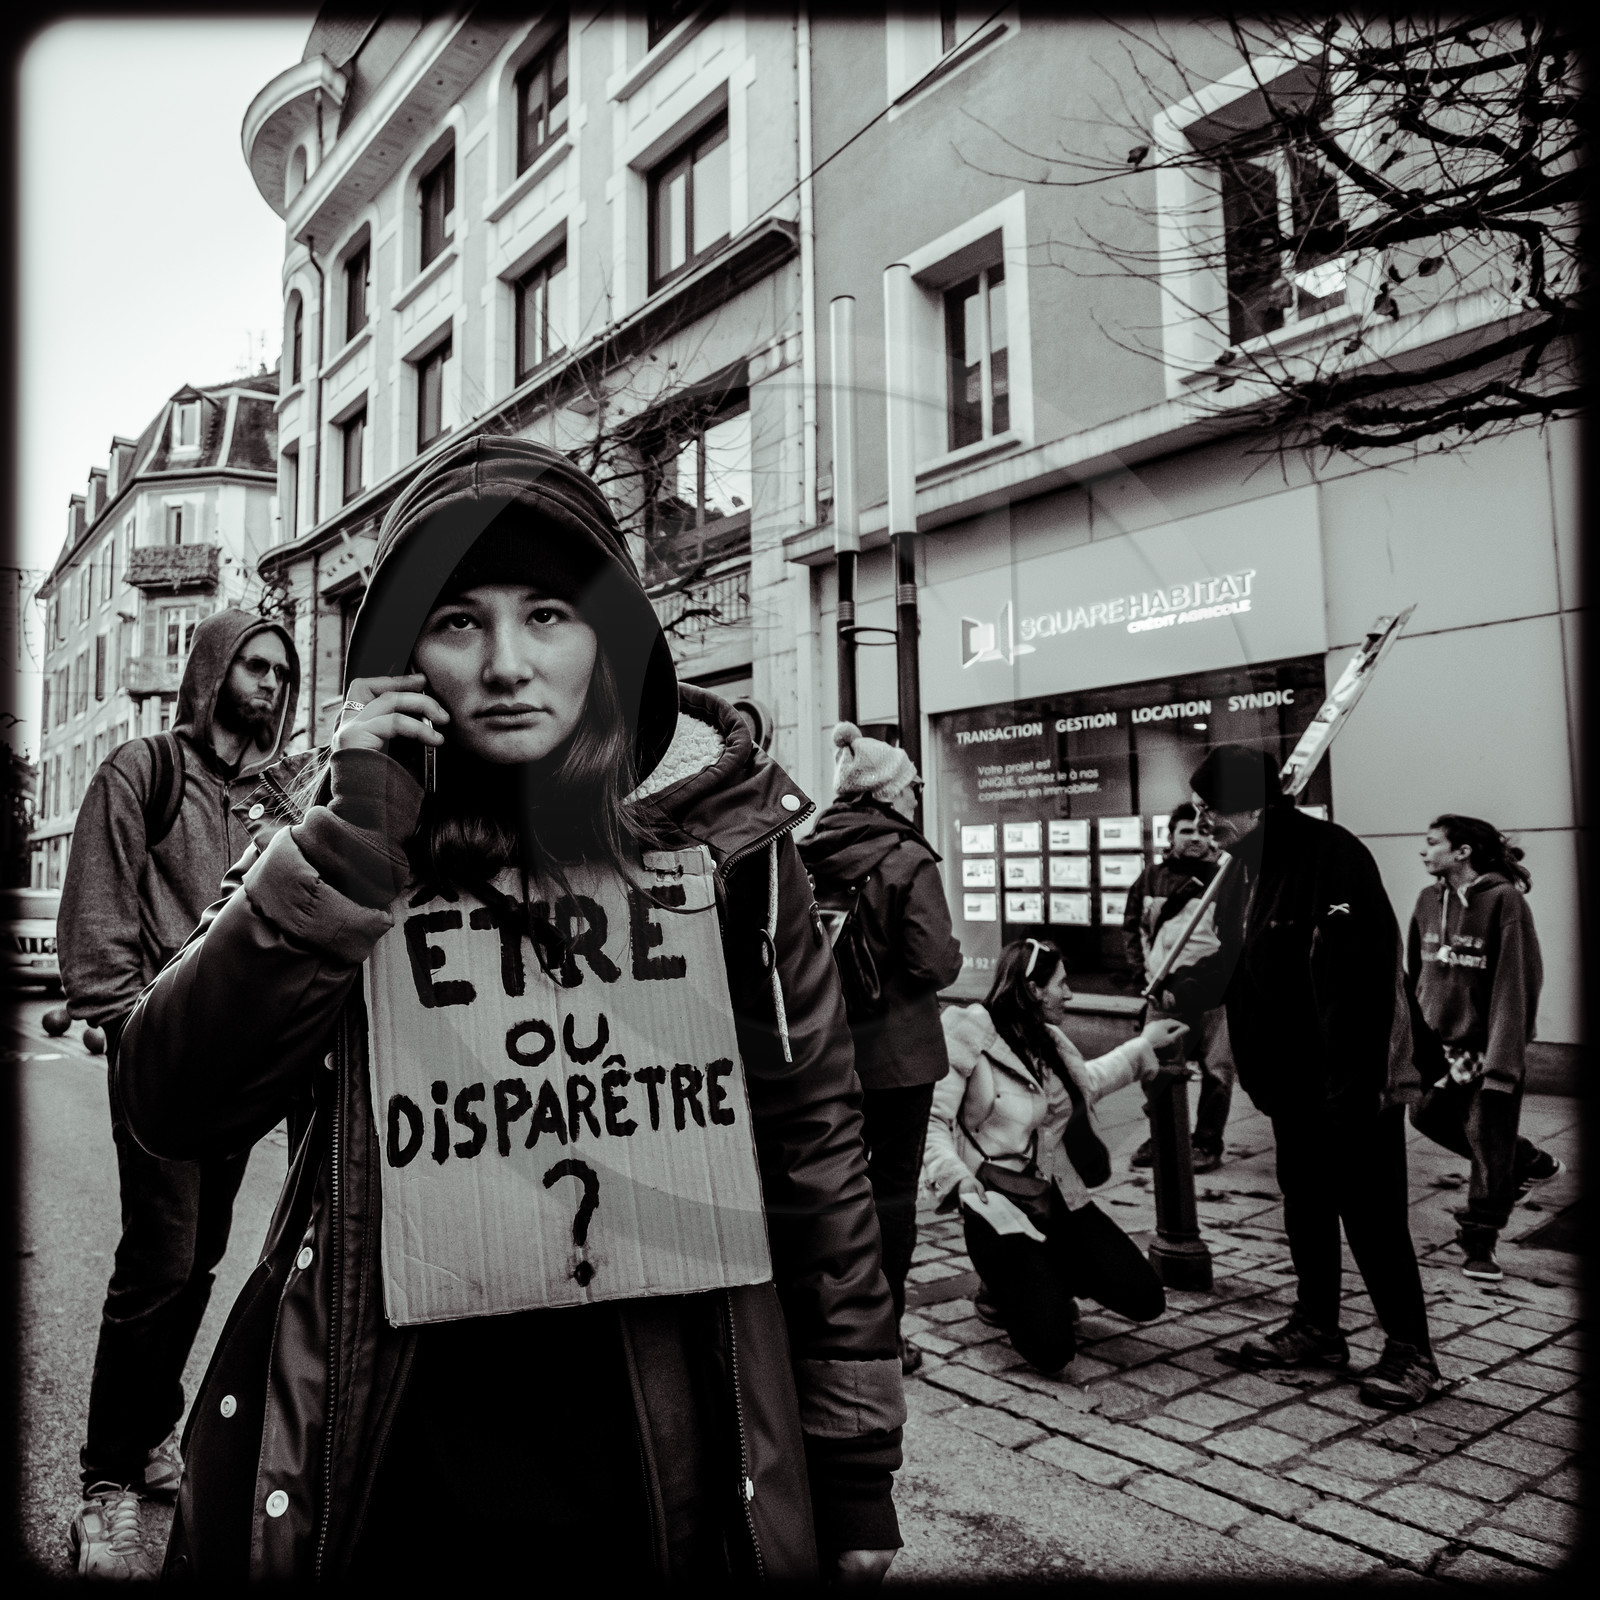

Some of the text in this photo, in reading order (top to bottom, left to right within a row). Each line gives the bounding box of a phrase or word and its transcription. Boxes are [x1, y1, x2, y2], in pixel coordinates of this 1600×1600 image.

[1020, 569, 1256, 641] SQUARE HABITAT
[1177, 599, 1252, 624] AGRICOLE
[956, 689, 1295, 745] TRANSACTION GESTION LOCATION SYNDIC
[978, 765, 1003, 776] Votre
[1005, 761, 1034, 774] projet
[1018, 772, 1055, 785] confiez
[1079, 769, 1099, 779] nos
[404, 884, 687, 1008] ÊTRE
[506, 1013, 610, 1067] OU
[542, 1158, 600, 1287] ?
